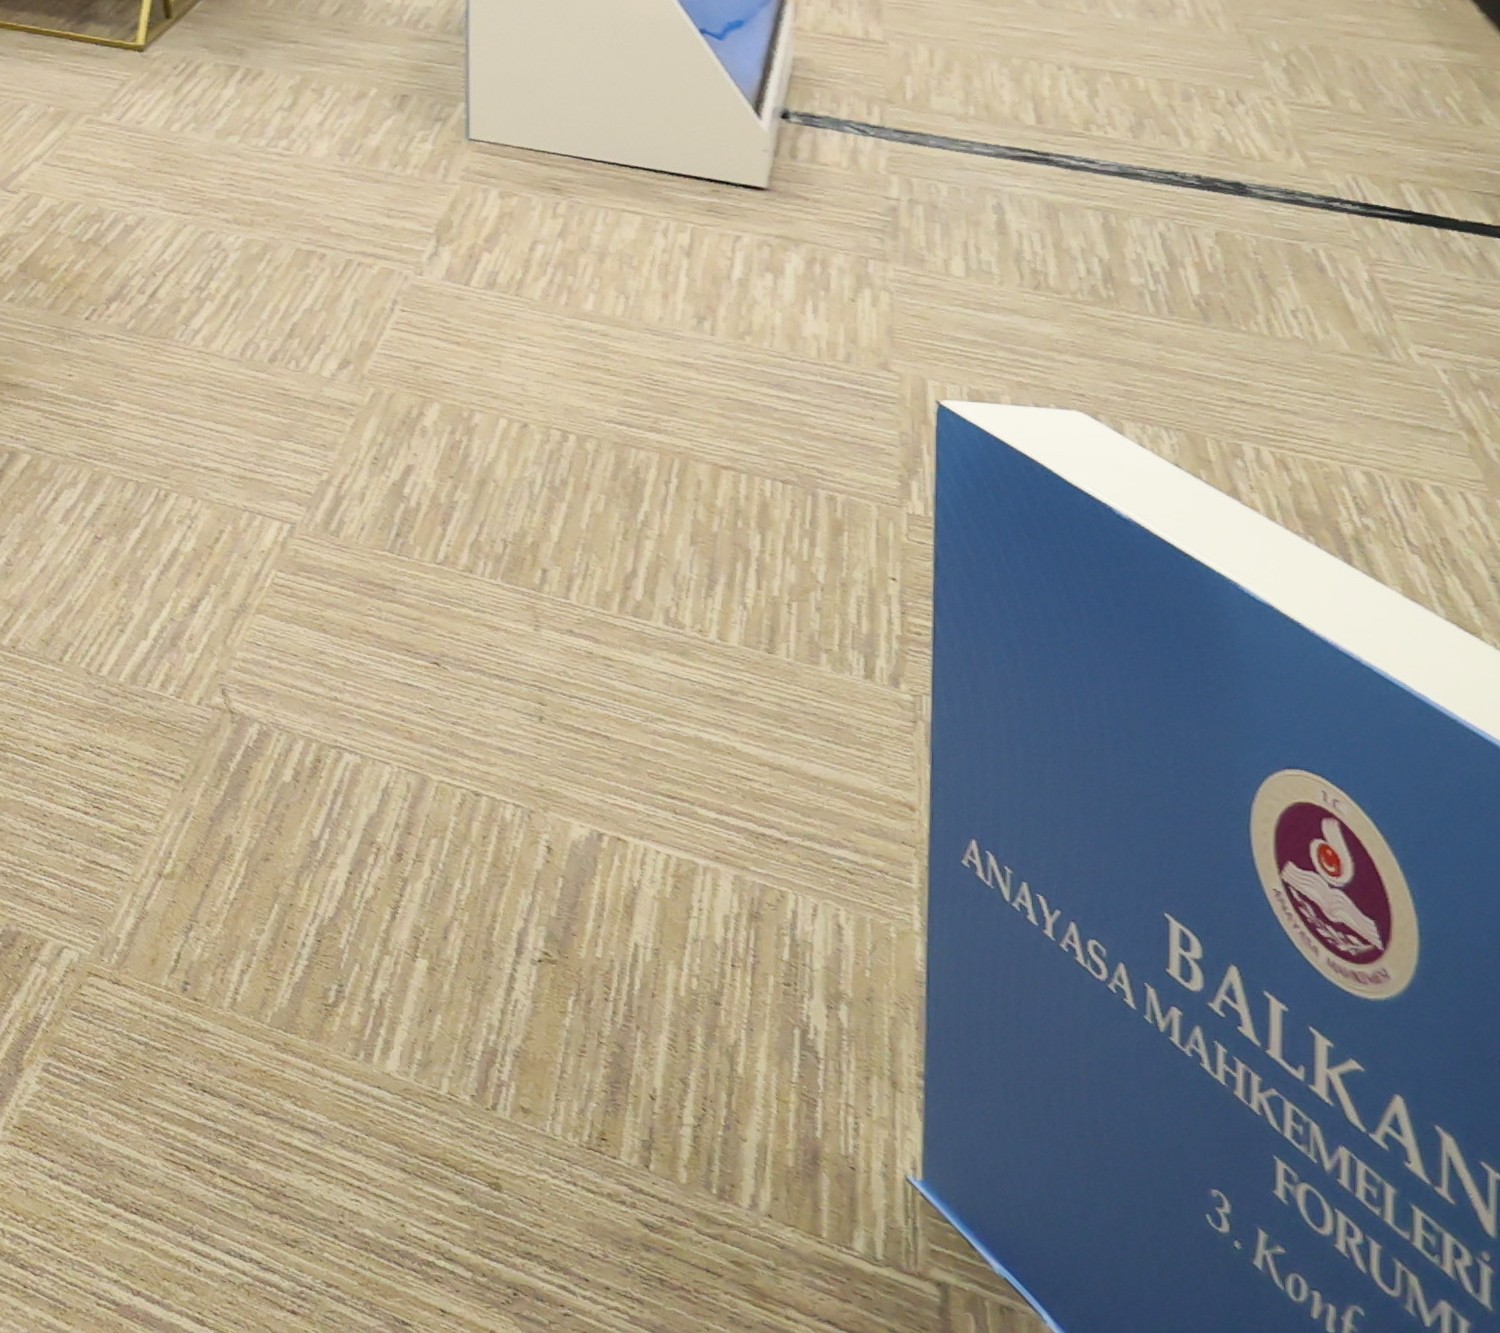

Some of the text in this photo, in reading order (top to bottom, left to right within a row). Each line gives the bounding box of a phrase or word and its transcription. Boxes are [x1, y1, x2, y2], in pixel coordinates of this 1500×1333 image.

[961, 839, 1493, 1312] ANAYASA MAHKEMELERİ
[1164, 912, 1500, 1239] BALKAN
[1205, 1188, 1242, 1250] 3.
